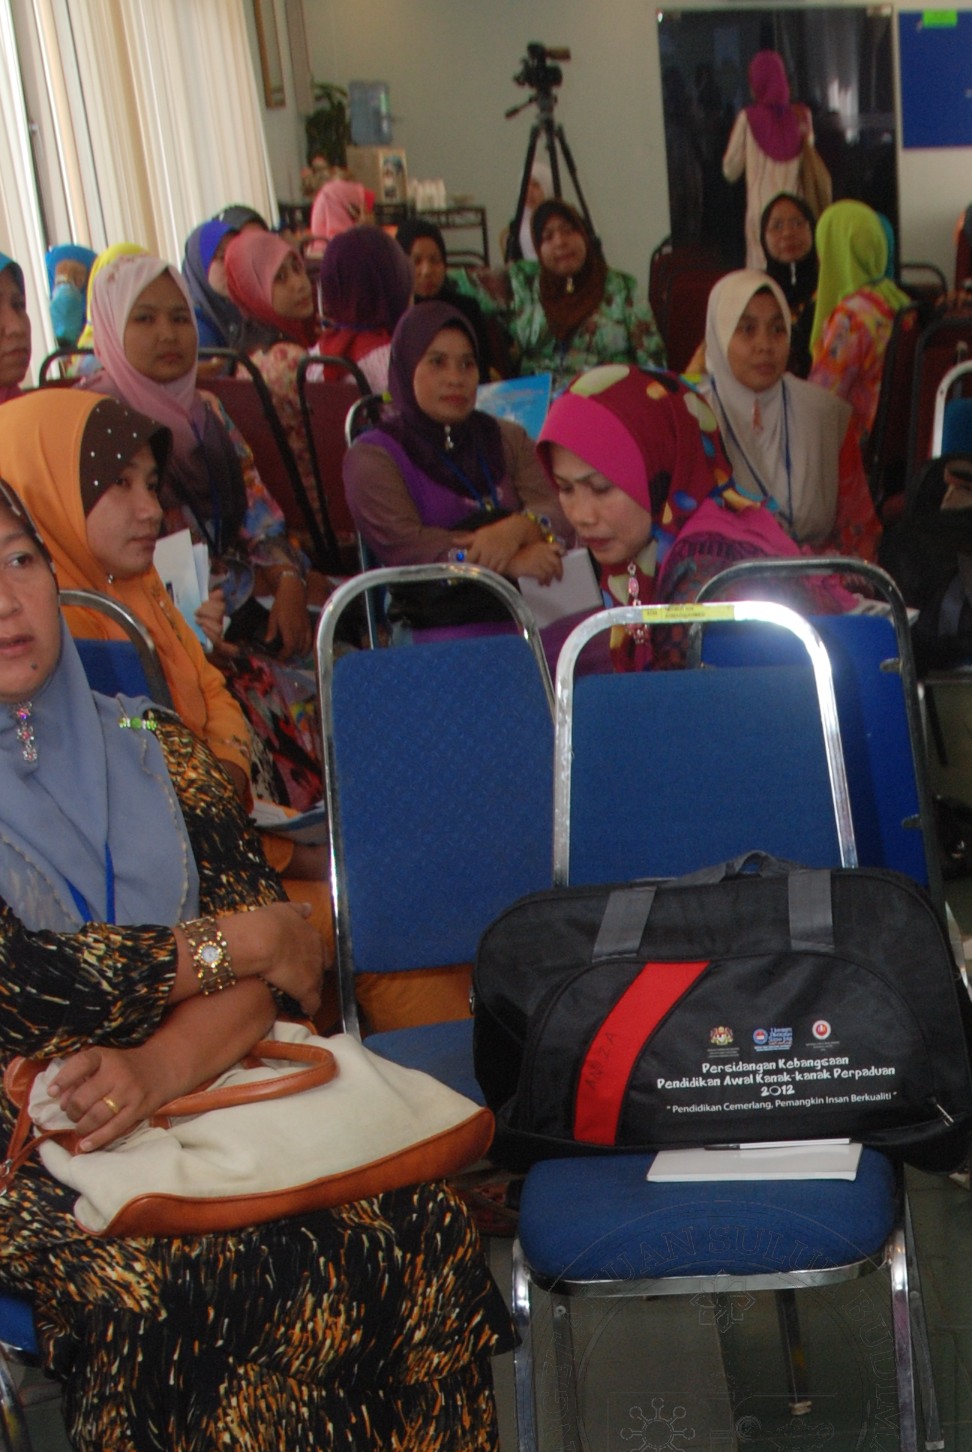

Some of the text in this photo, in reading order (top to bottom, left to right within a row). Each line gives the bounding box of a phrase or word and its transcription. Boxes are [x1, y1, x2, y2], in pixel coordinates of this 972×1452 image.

[702, 1056, 849, 1074] Persidangan Kebangsaan
[657, 1066, 896, 1089] Pendidikan Awal Kanak-kanak Perpaduan
[760, 1085, 795, 1097] 2012
[723, 1100, 774, 1112] Cemerlang,
[775, 1096, 825, 1108] Pemangkin
[825, 1094, 849, 1105] Insan
[850, 1091, 892, 1103] Berkualiti
